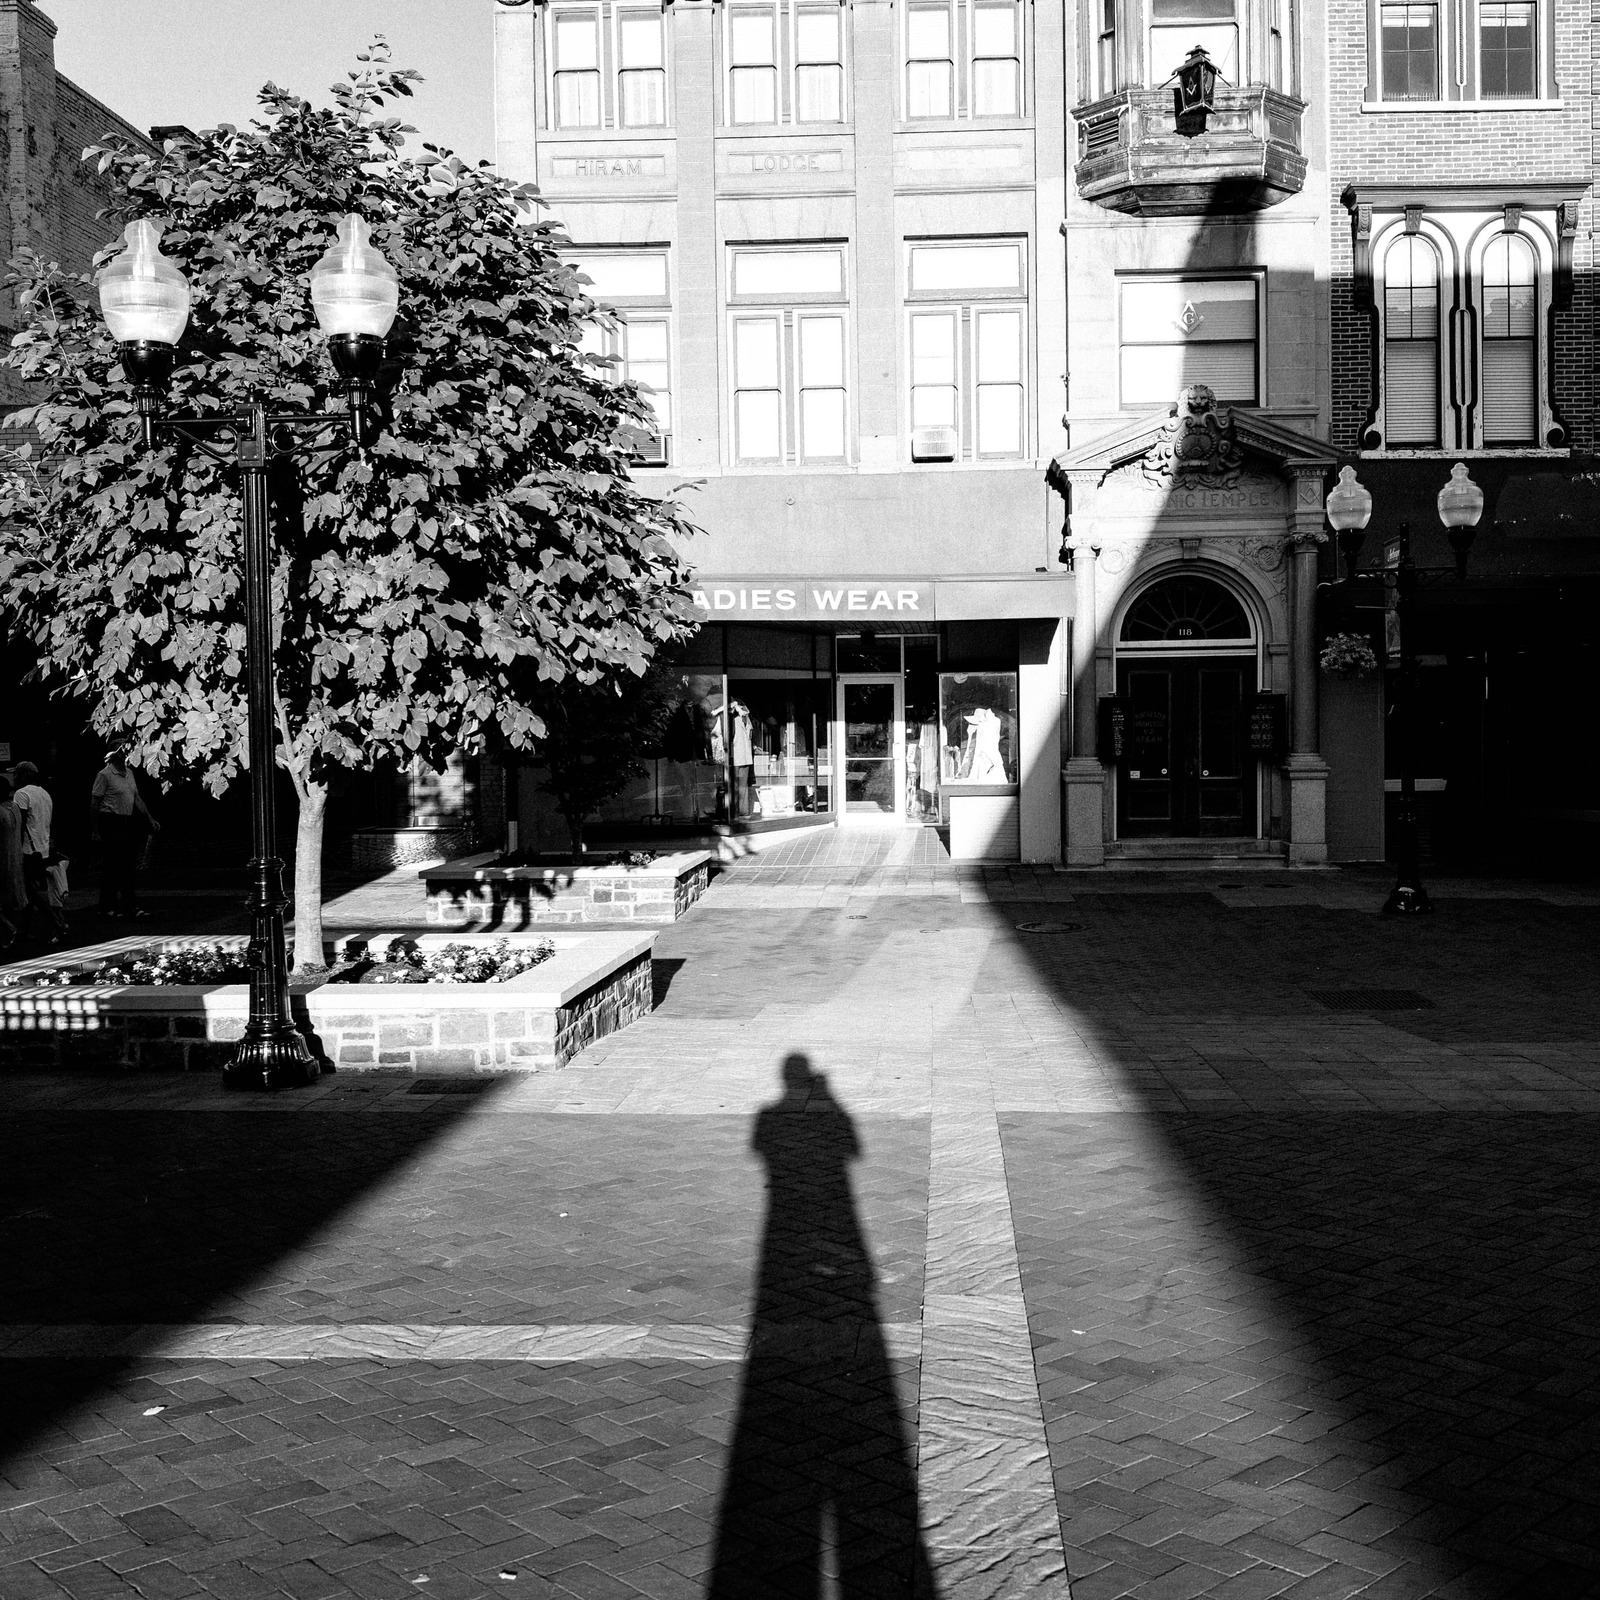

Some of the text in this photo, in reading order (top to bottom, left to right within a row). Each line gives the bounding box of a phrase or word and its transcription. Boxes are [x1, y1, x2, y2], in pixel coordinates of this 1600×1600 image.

[575, 159, 643, 176] HIRAM
[751, 154, 820, 173] LODGE
[1197, 488, 1270, 508] TEMPLE
[693, 589, 920, 610] ADIES WEAR
[1178, 628, 1193, 636] 118
